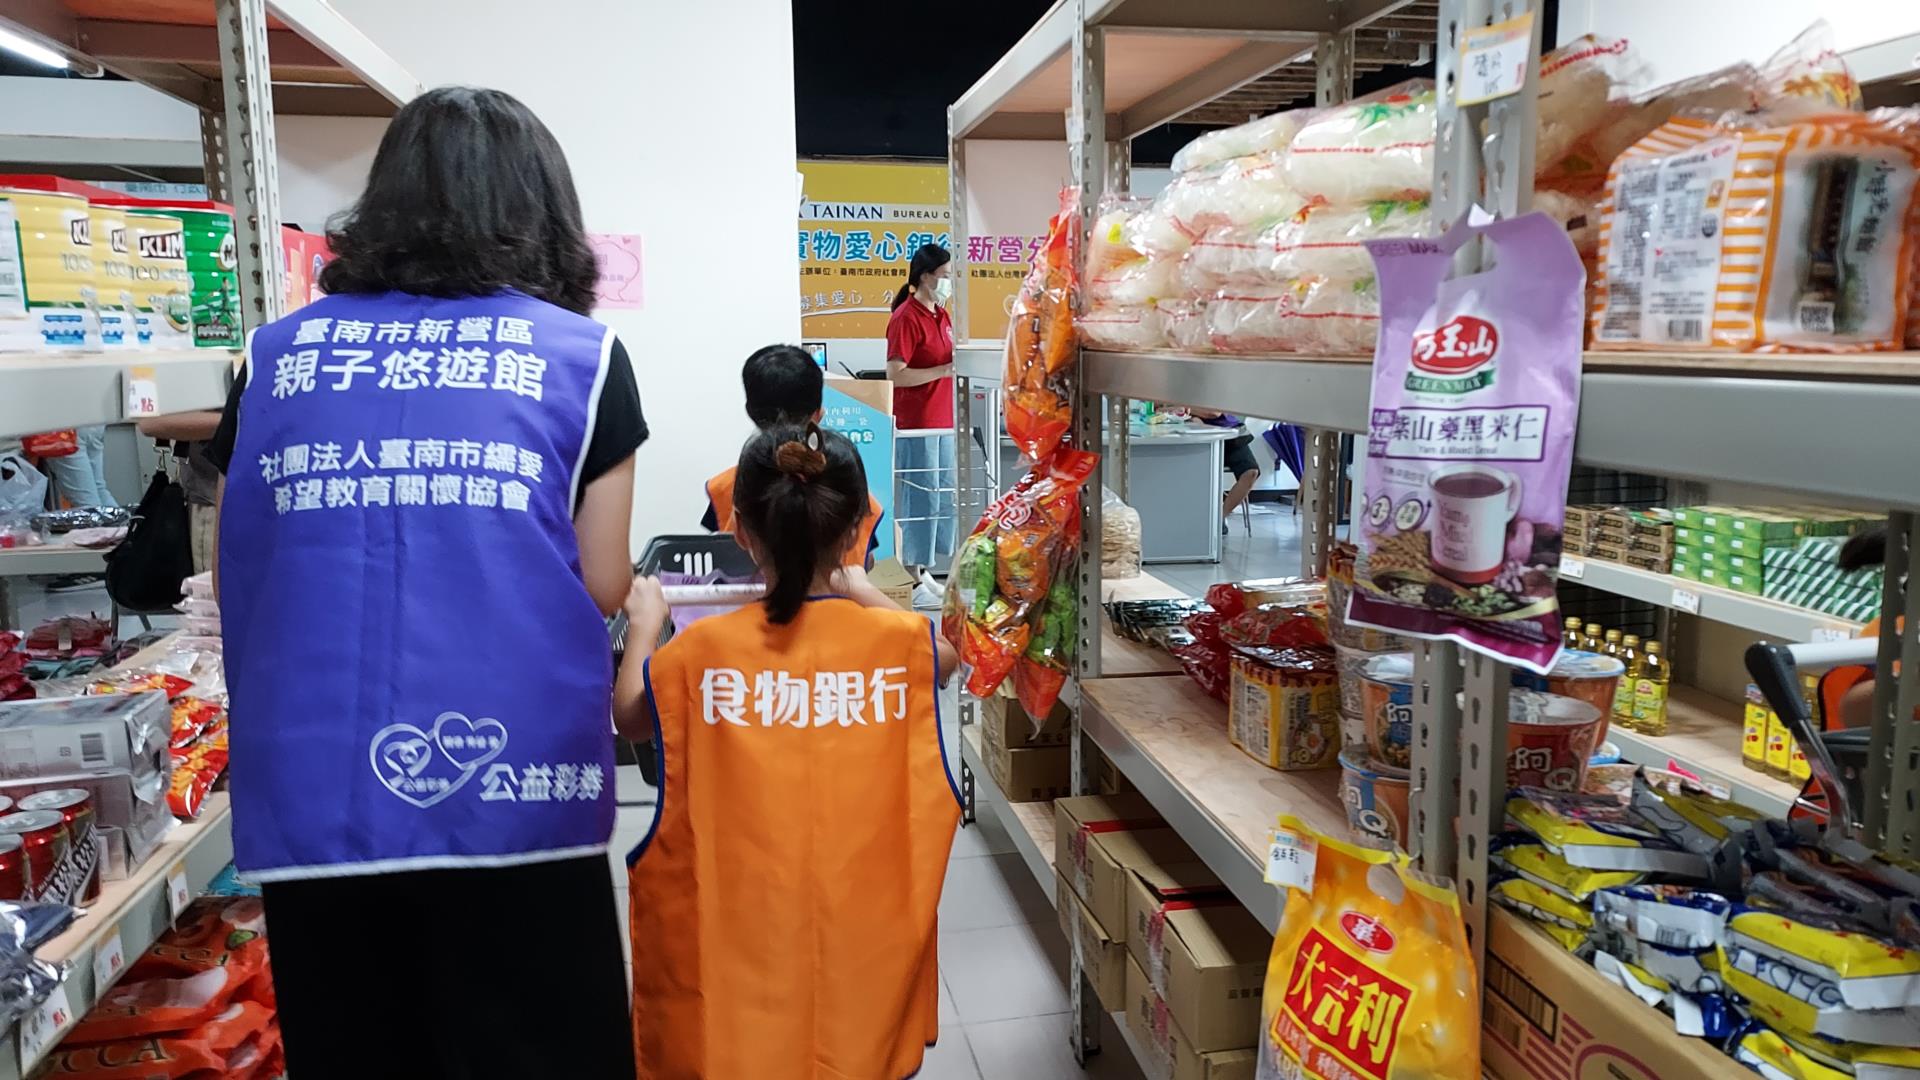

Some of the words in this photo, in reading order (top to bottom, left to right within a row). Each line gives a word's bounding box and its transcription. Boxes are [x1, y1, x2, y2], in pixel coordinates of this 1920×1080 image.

[810, 204, 883, 220] TAINAN
[893, 210, 939, 219] BUREAU
[141, 234, 184, 258] KLIM
[292, 316, 535, 346] 臺南市新營區
[271, 348, 547, 401] 親子悠遊館
[274, 474, 532, 514] 希望教育關懷協會
[699, 667, 908, 728] 食物銀行
[479, 762, 605, 802] 公益彩券
[1288, 942, 1403, 1064] 大吉利
[60, 1038, 175, 1073] CCA
